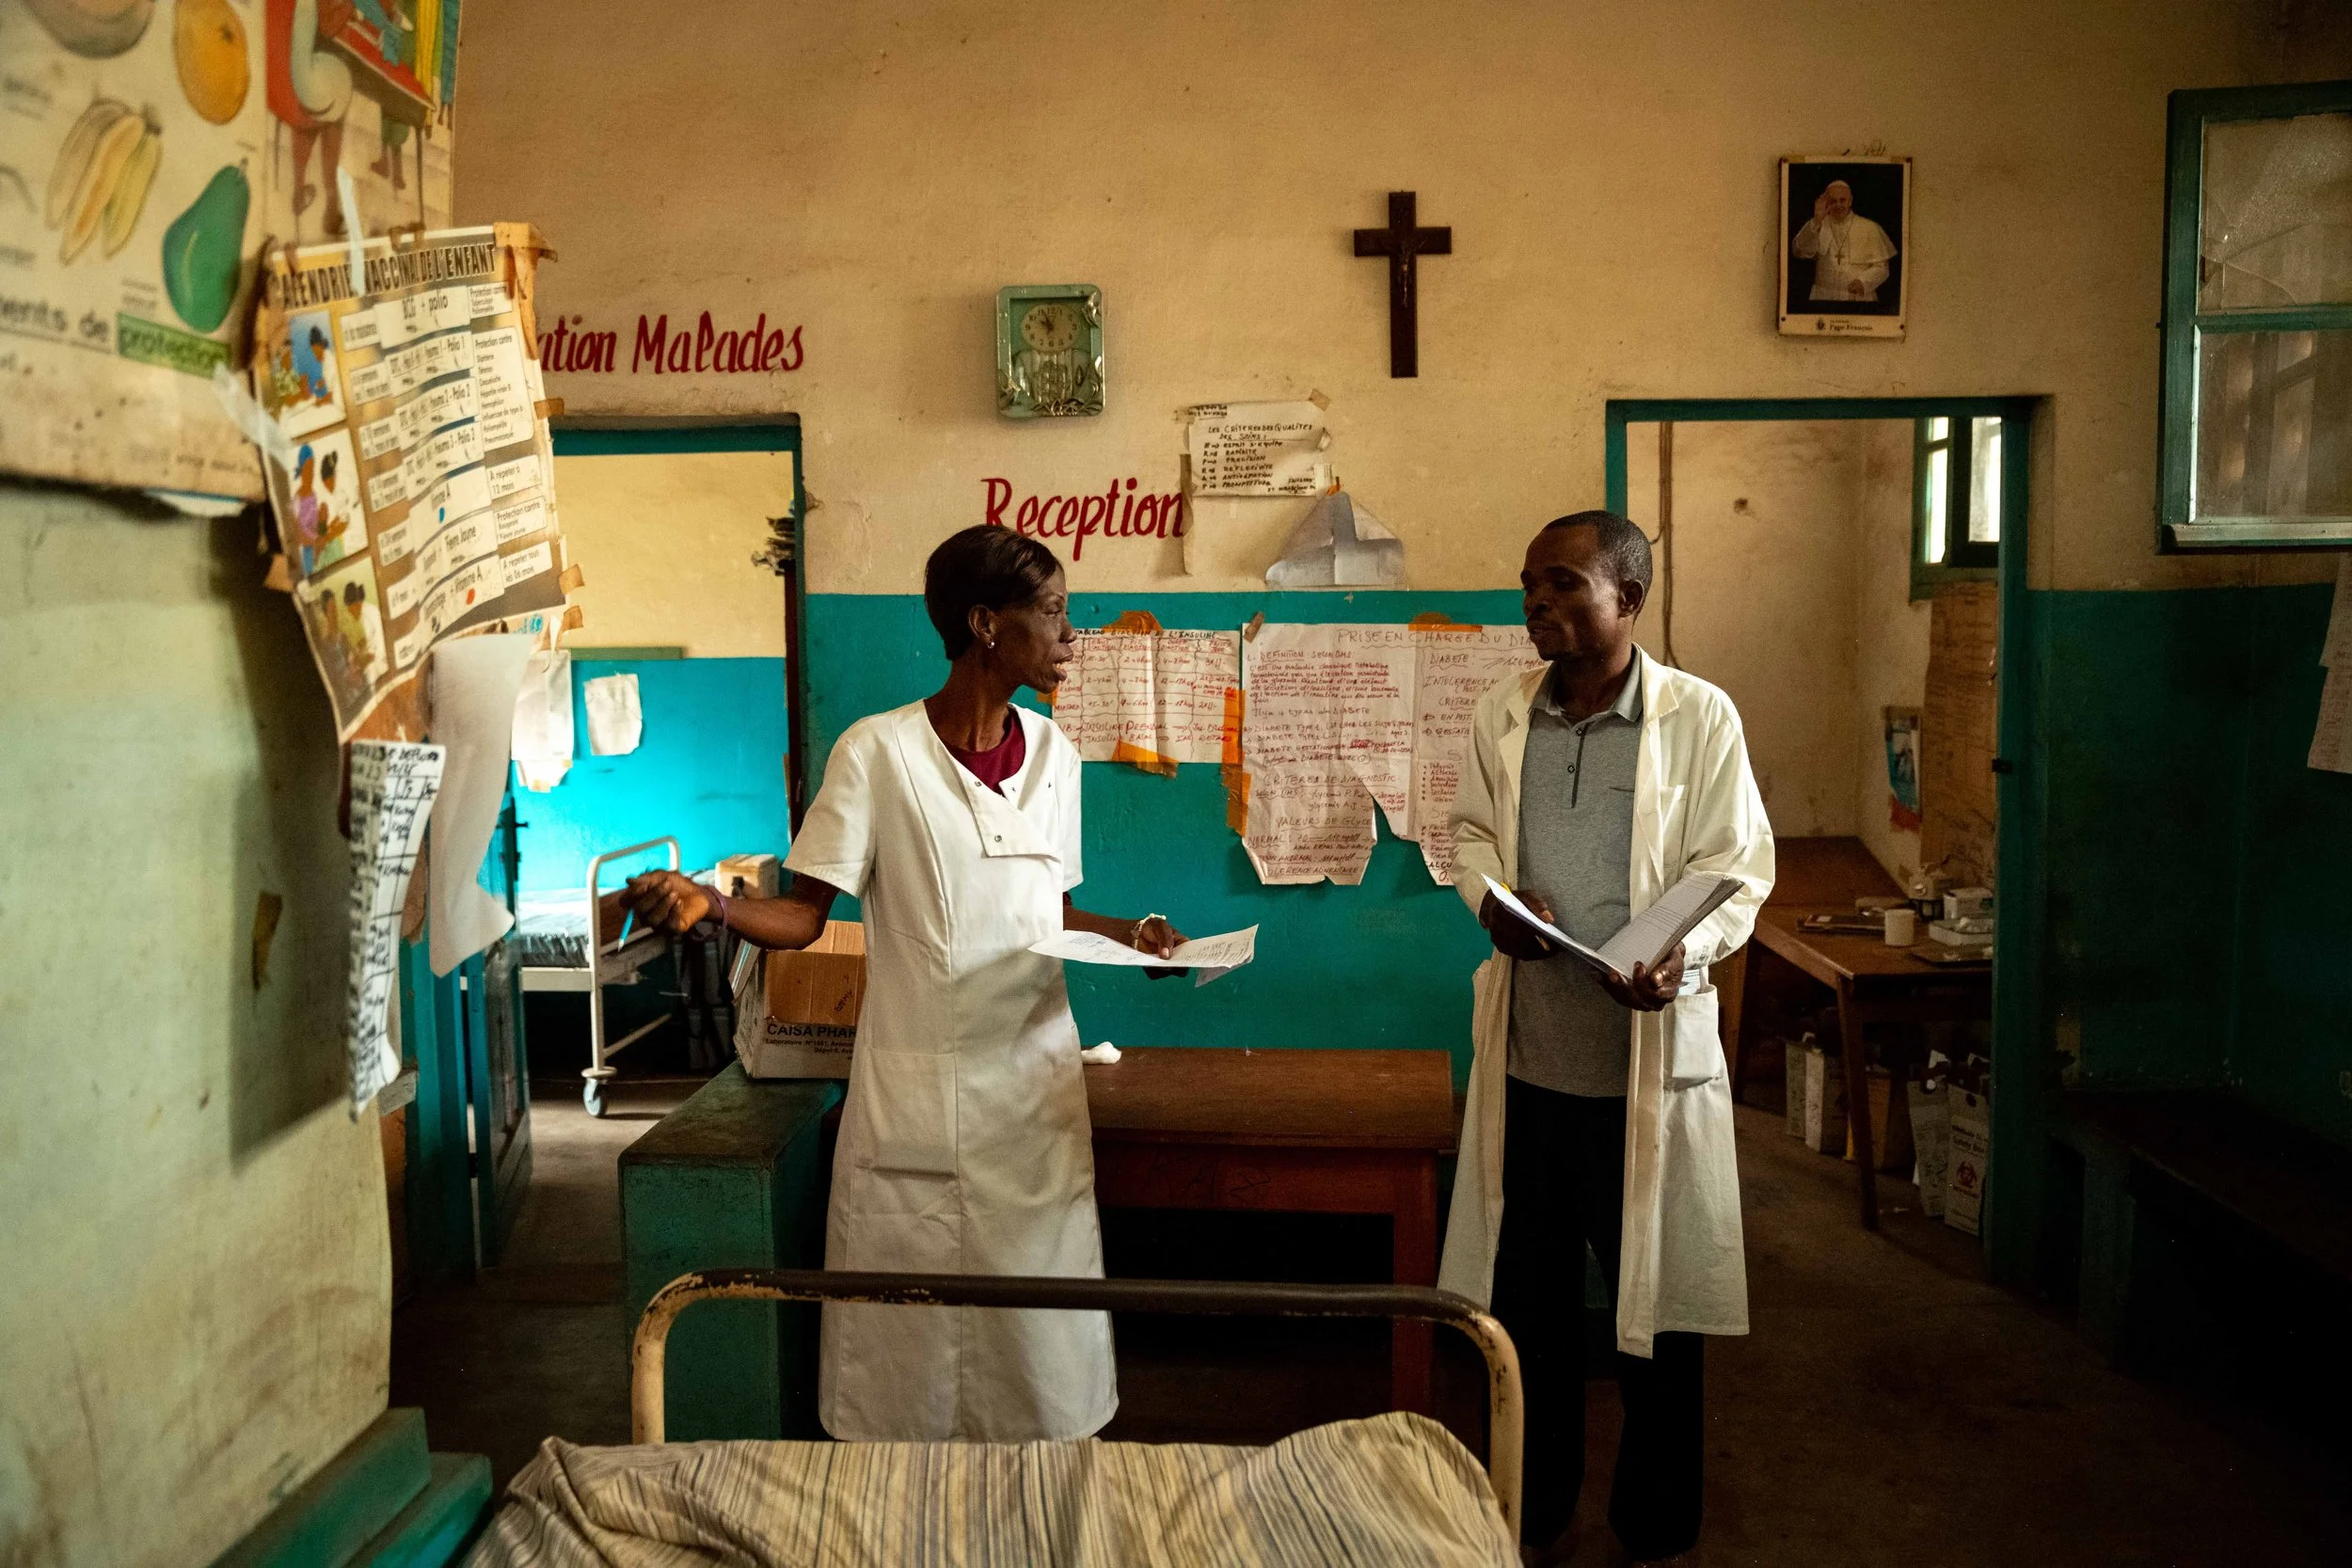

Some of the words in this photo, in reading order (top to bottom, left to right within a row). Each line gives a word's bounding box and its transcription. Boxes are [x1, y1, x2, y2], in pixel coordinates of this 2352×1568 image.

[267, 263, 363, 310] ALENDRIE
[429, 294, 449, 317] polio
[631, 309, 804, 375] Malades
[981, 476, 1184, 562] Reception
[1337, 628, 1382, 643] PRISE
[1385, 630, 1404, 642] EN
[1407, 632, 1474, 643] CHARGE
[1479, 632, 1502, 643] DU
[1424, 861, 1454, 869] ALCU
[767, 1023, 813, 1037] CAISA
